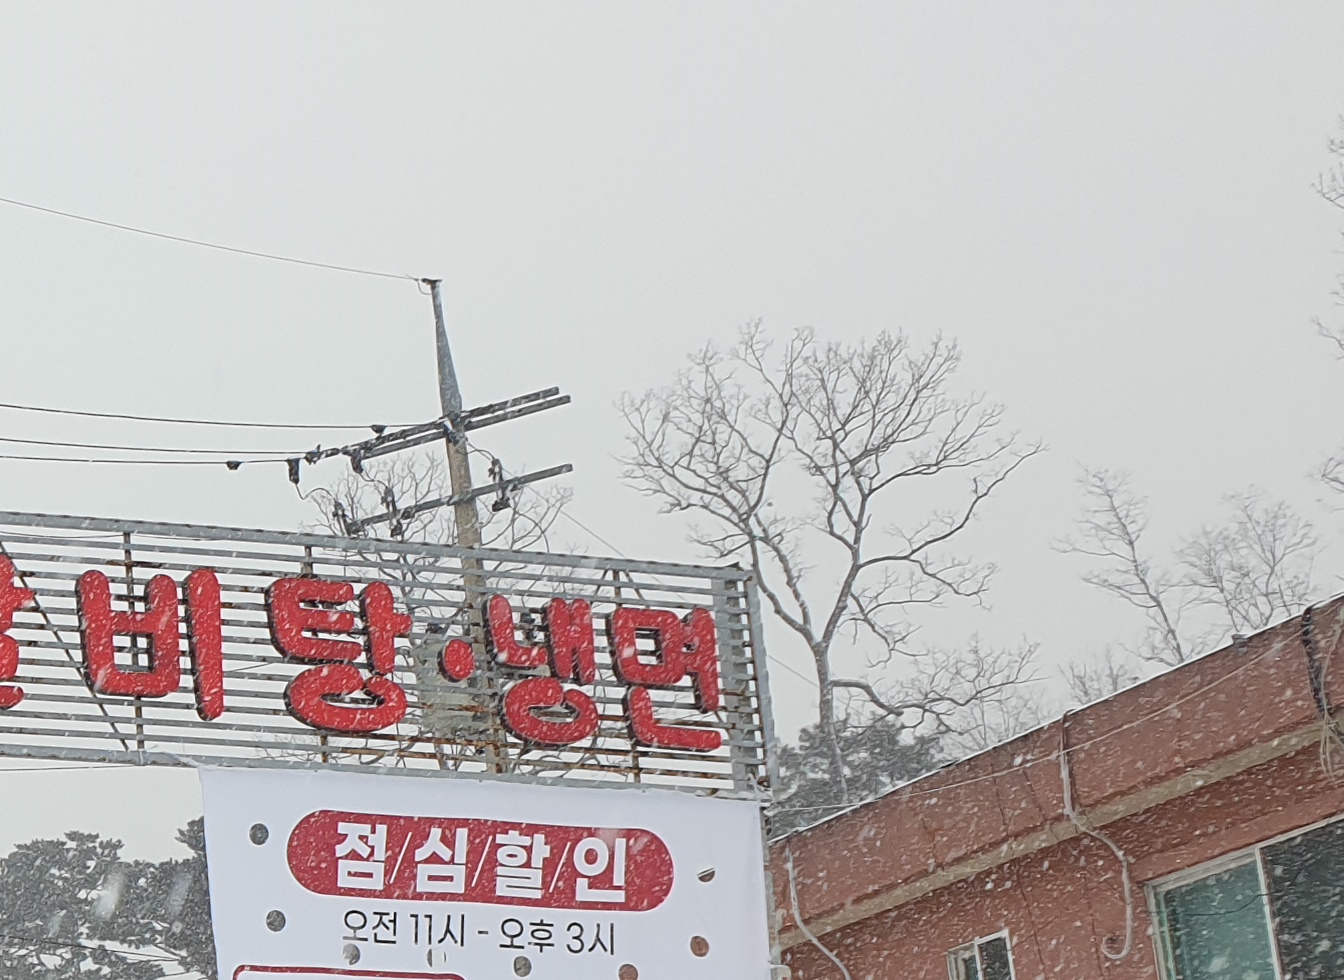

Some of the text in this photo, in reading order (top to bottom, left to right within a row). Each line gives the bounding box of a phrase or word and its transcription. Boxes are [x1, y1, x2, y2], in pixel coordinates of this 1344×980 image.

[341, 909, 399, 946] 오전
[409, 912, 467, 949] 11시
[499, 917, 556, 954] 오후
[566, 921, 617, 957] 3시
